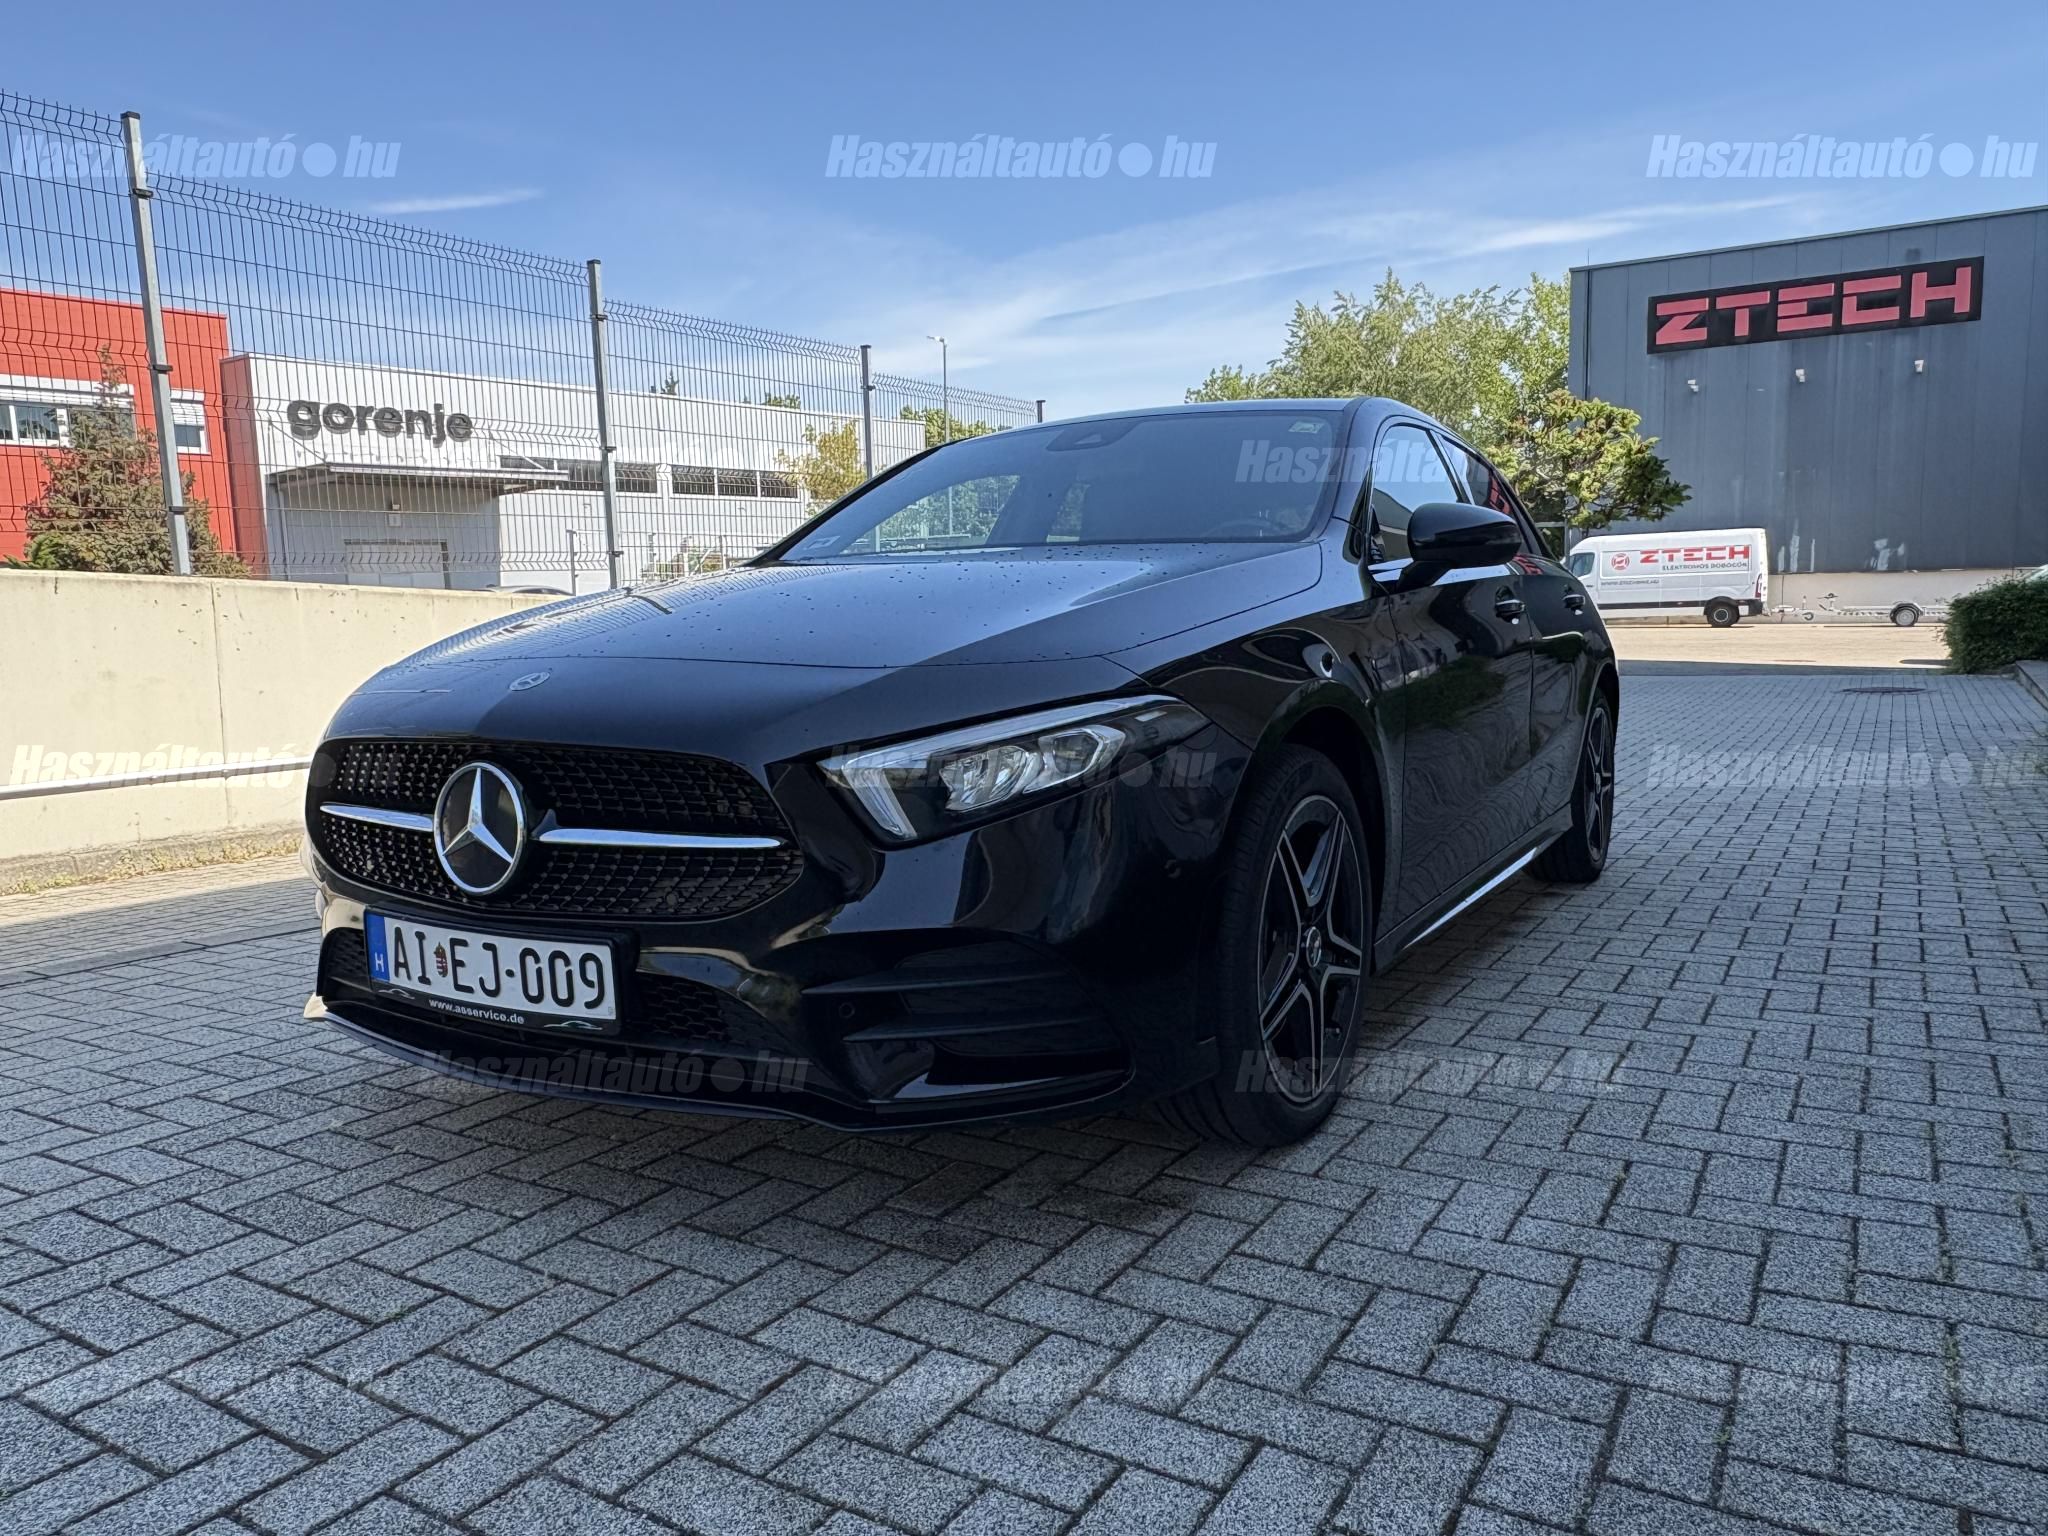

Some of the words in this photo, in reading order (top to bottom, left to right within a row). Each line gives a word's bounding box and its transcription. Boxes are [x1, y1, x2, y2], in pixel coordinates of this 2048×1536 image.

[1656, 266, 1972, 345] ZTECH
[287, 400, 473, 448] gorenje
[1640, 546, 1749, 563] ZTECH
[374, 951, 385, 974] H
[428, 999, 525, 1025] www.asservice.de
